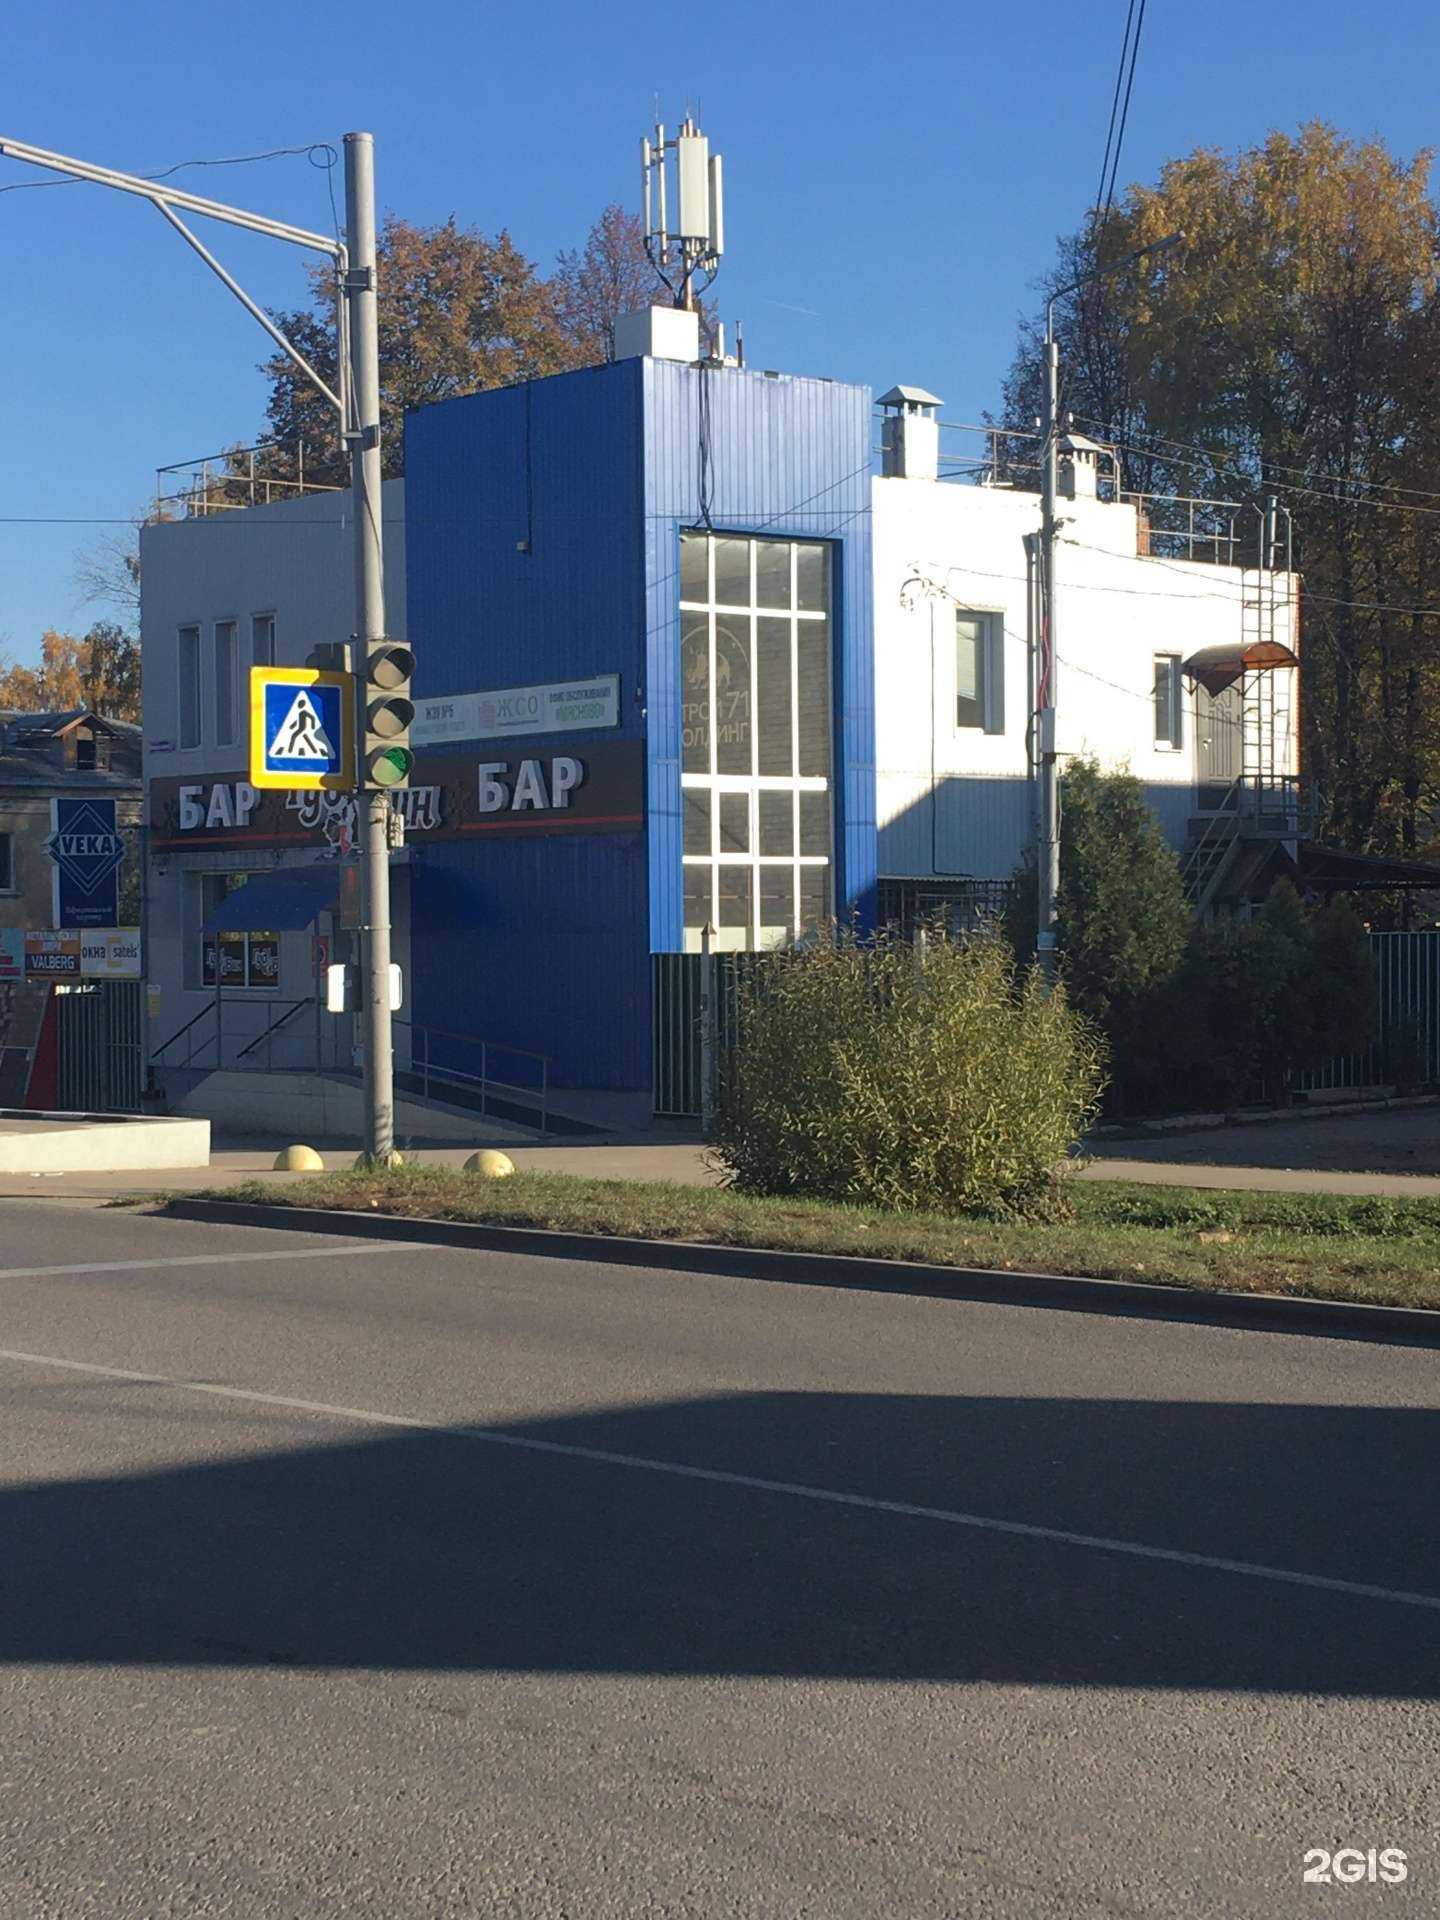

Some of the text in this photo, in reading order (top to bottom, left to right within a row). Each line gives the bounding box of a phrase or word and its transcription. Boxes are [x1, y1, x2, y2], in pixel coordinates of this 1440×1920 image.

[497, 695, 538, 718] ЖСО
[726, 691, 749, 719] 71
[478, 757, 583, 812] БАР
[179, 782, 260, 830] БАР
[61, 836, 114, 853] VEKA
[31, 955, 75, 969] VALBERG
